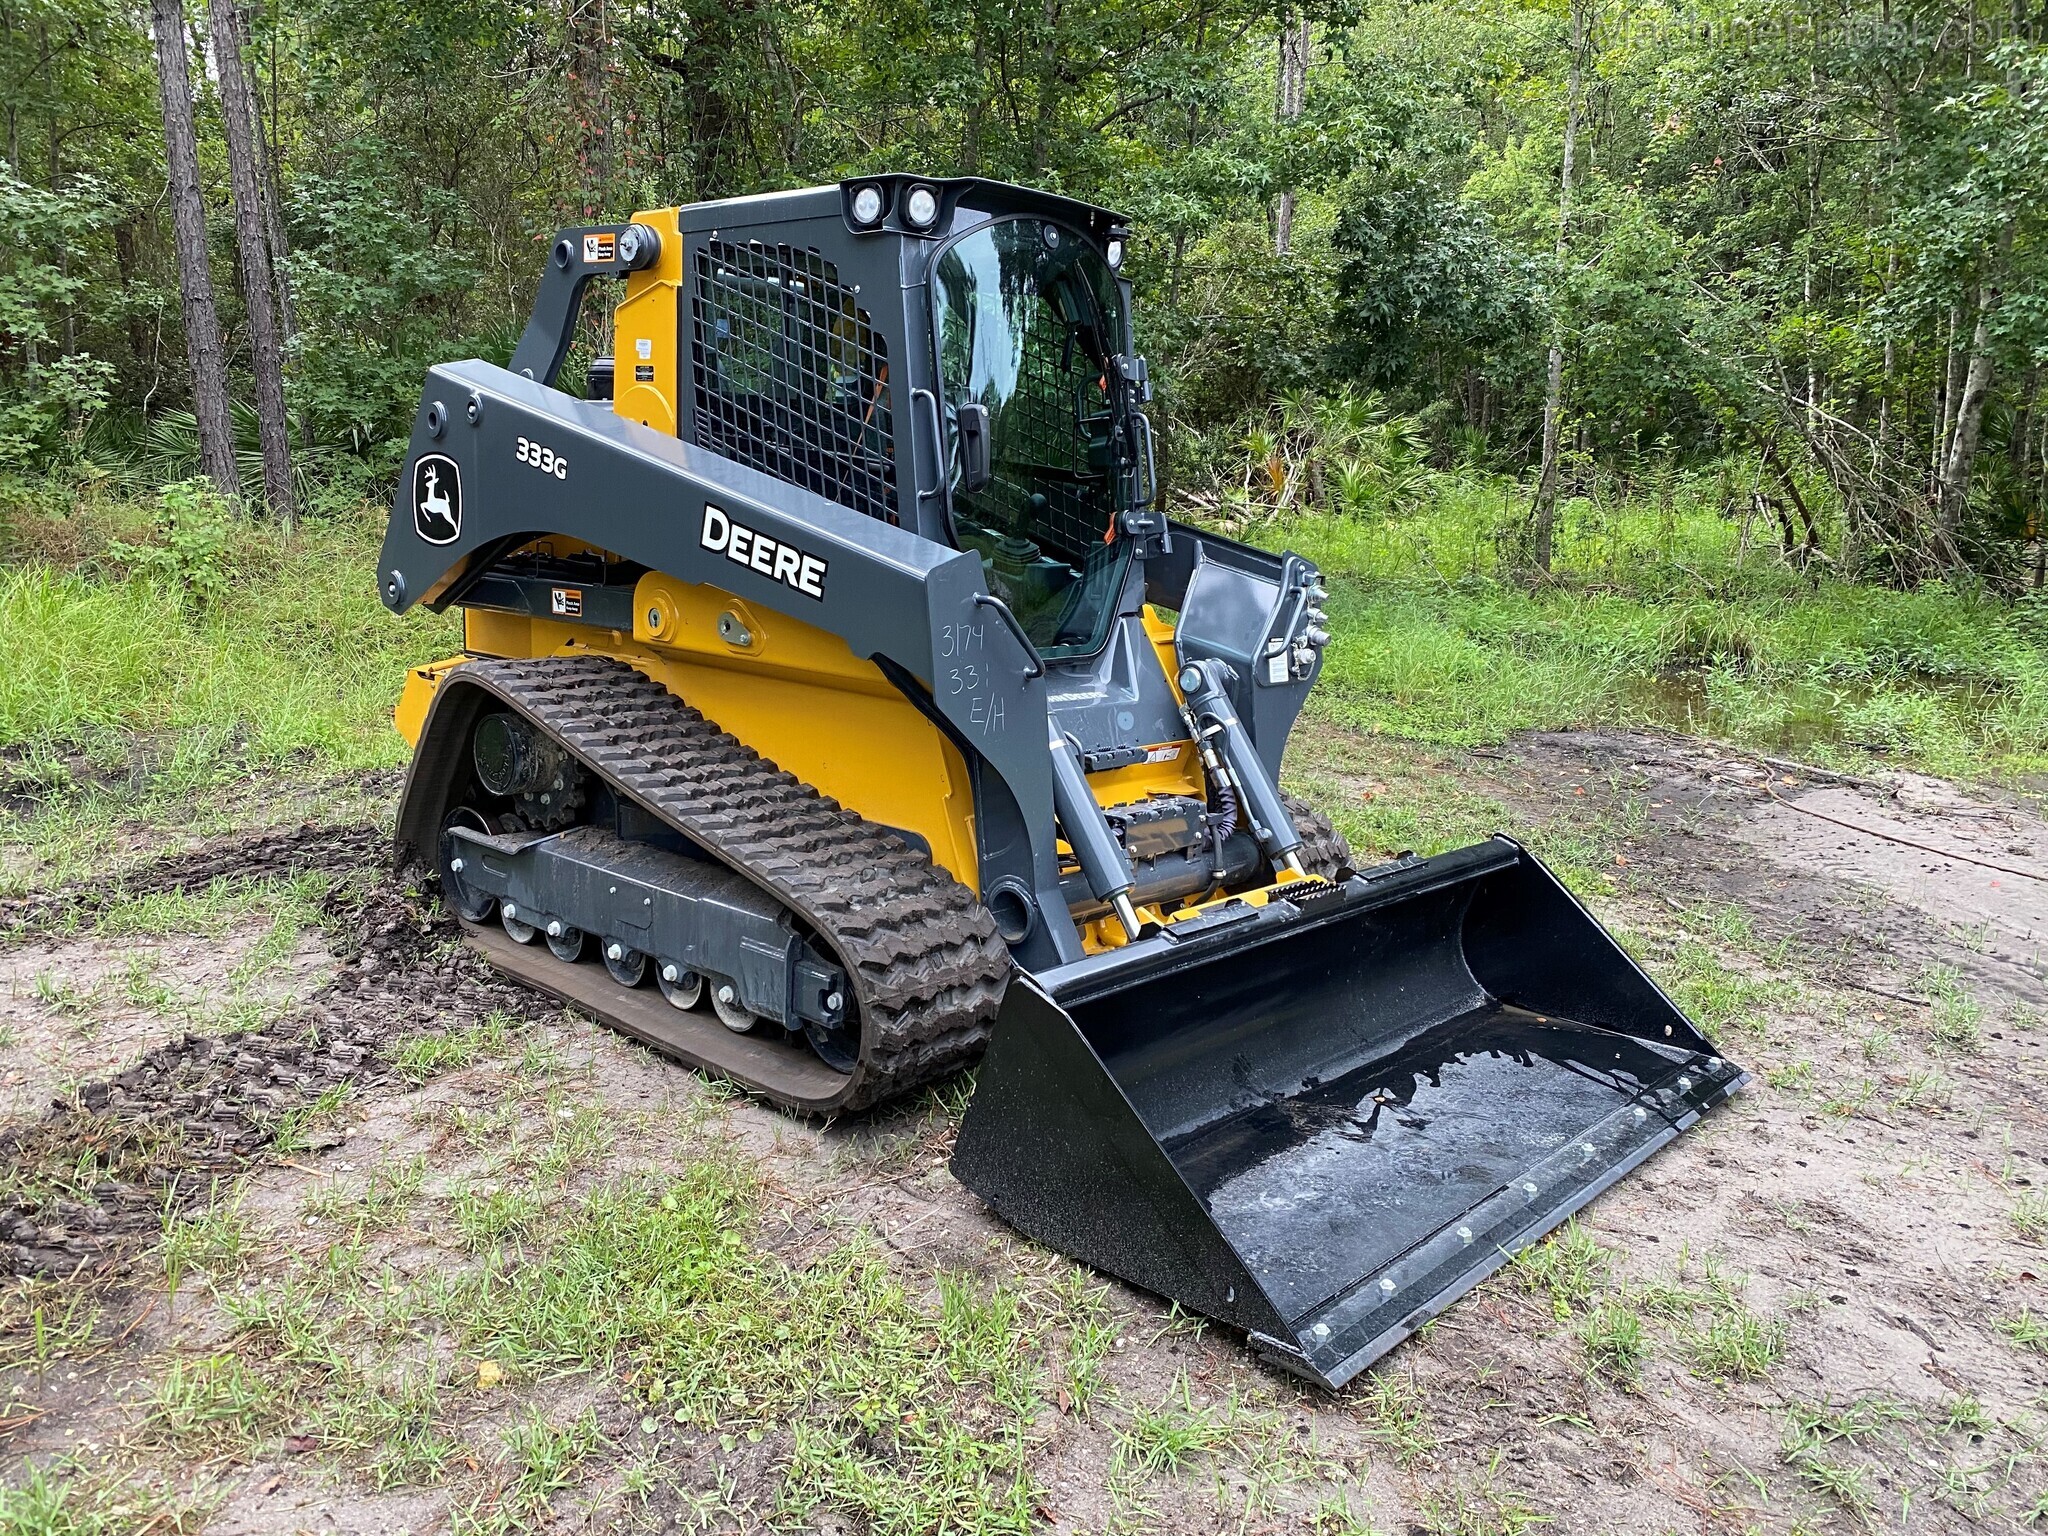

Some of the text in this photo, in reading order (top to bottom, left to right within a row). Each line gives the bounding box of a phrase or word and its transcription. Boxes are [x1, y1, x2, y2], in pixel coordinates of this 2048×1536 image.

[515, 436, 568, 480] 333G
[701, 504, 827, 598] DEERE
[941, 622, 984, 657] 3174
[969, 692, 1005, 736] E/H
